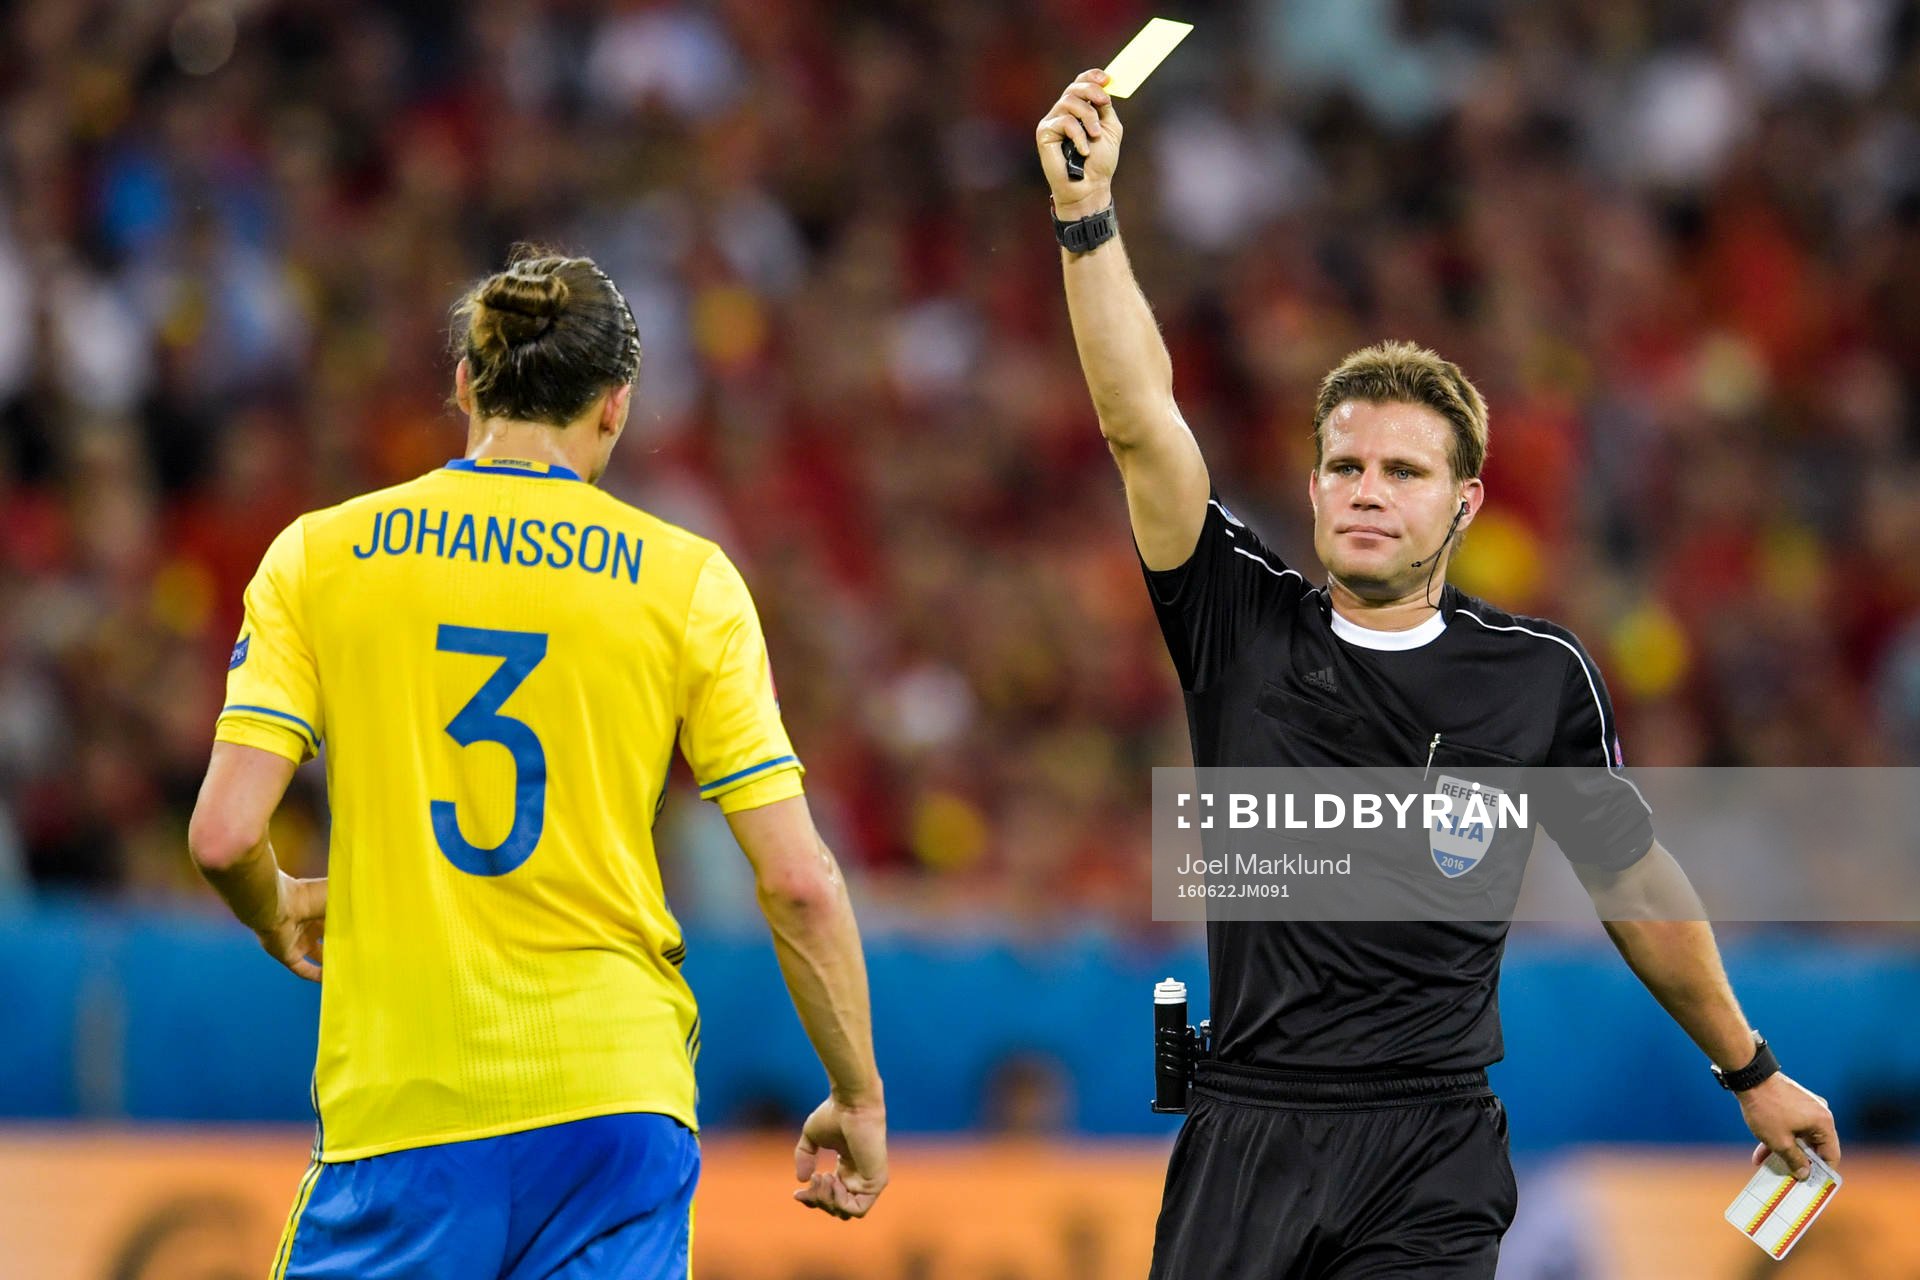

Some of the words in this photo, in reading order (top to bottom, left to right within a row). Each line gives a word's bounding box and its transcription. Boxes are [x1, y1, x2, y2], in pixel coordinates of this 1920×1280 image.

[353, 508, 643, 584] JOHANSSON
[430, 623, 548, 877] 3
[1441, 783, 1498, 807] REFEEE
[1441, 855, 1465, 870] 2016
